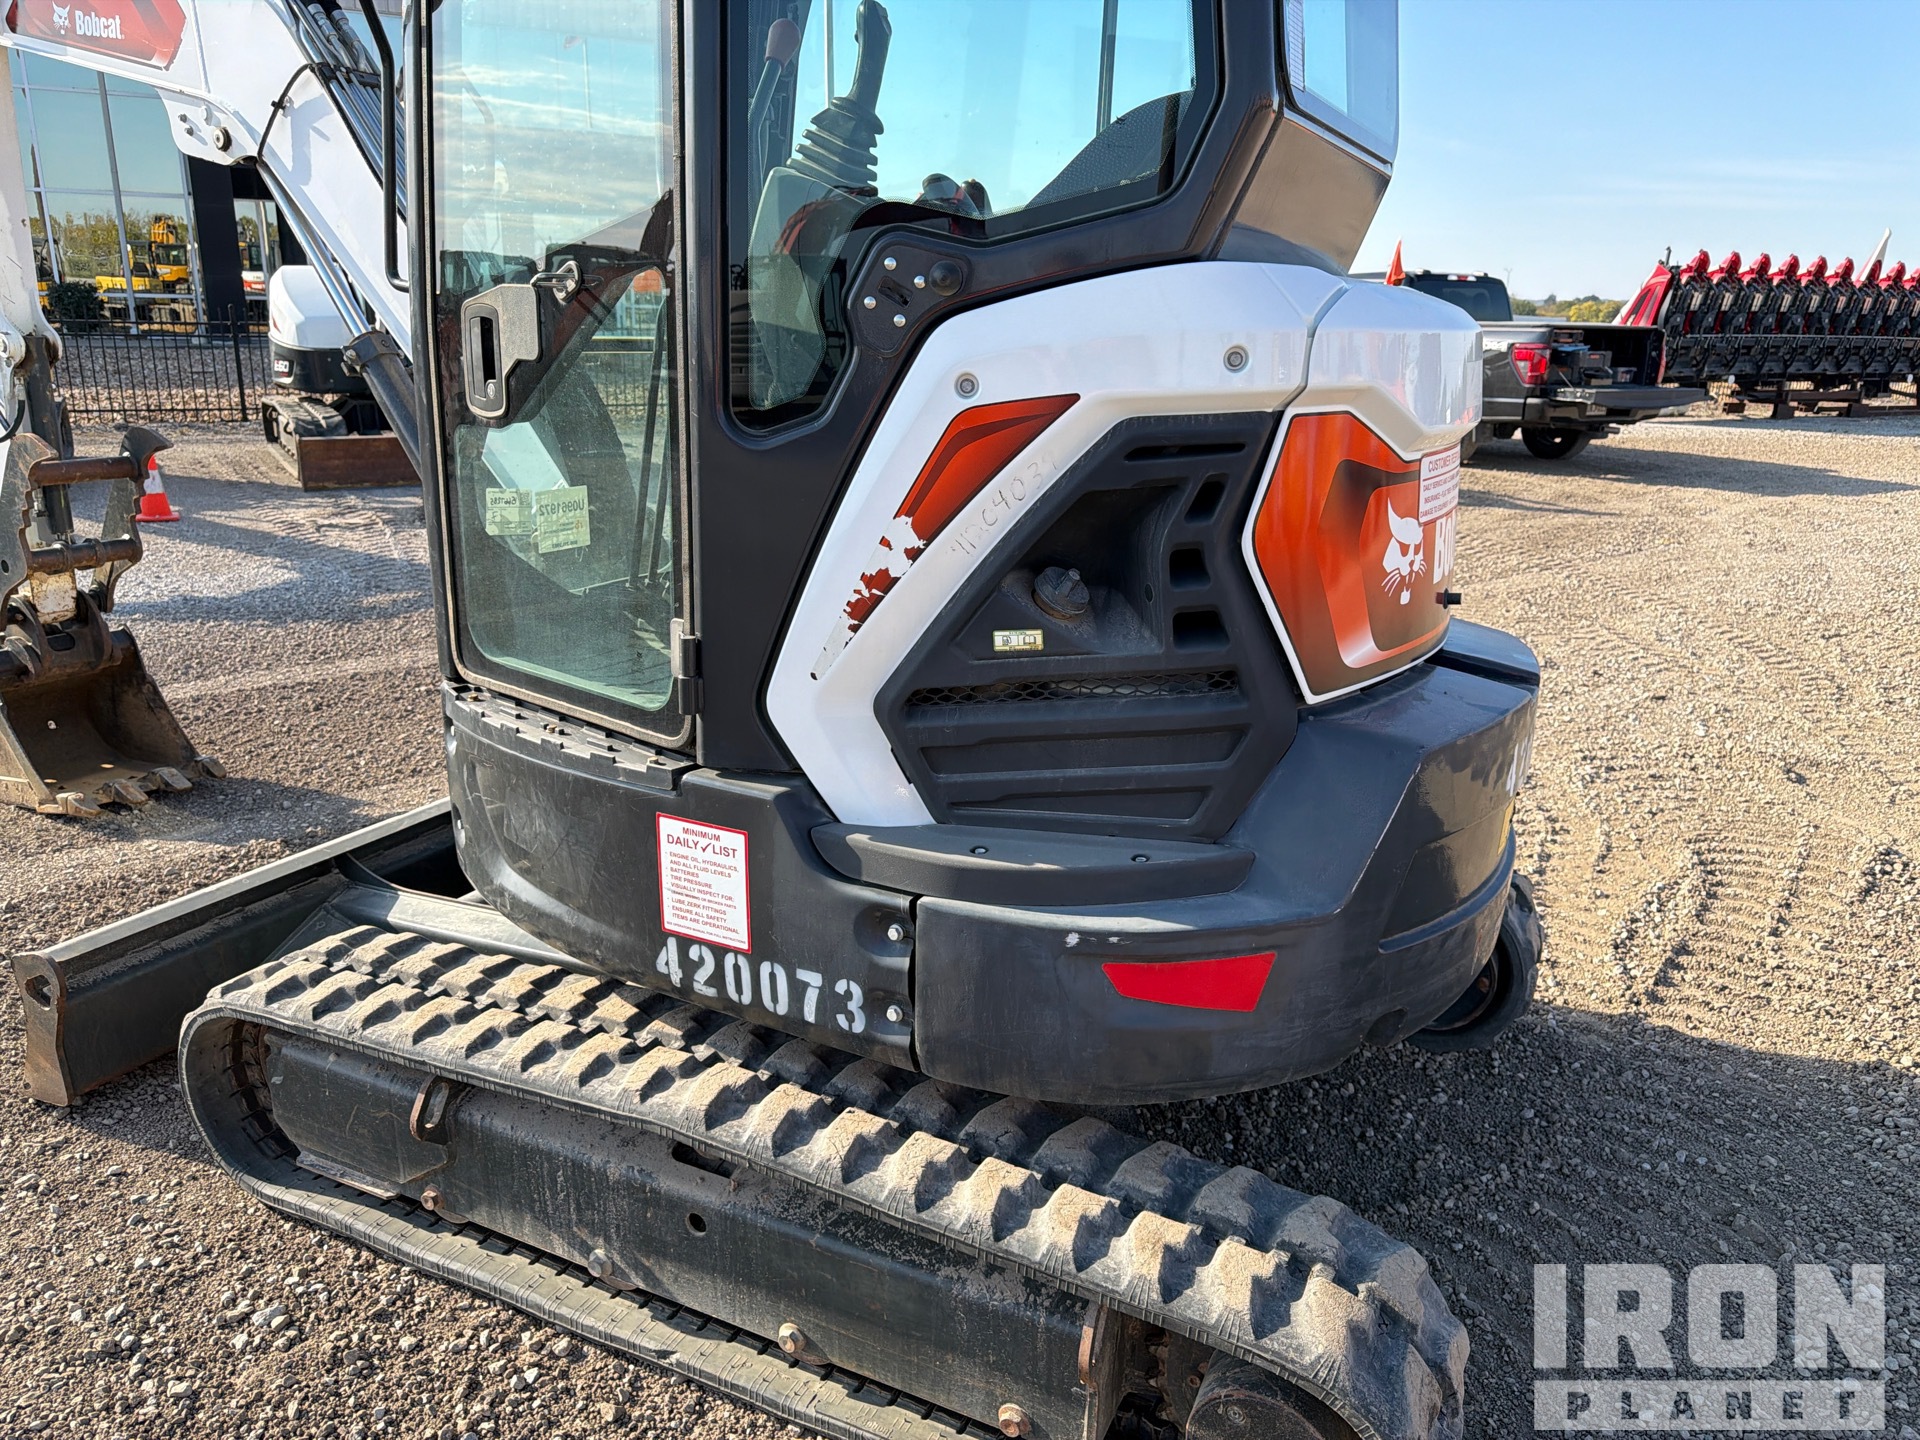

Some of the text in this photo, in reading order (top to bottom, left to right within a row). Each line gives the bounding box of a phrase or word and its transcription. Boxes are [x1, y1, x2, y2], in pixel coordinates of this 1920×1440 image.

[75, 10, 122, 40] Bobcat
[682, 826, 720, 841] MINIMUM
[666, 833, 737, 858] DAILY LIST
[669, 851, 688, 860] ENGINE
[670, 867, 698, 878] BATTERIES
[710, 868, 731, 877] LEVELS
[670, 882, 695, 892] VISUALLY
[697, 888, 719, 898] INSPECT
[683, 877, 712, 888] PRESSURE
[672, 905, 693, 914] ENSURE
[706, 913, 726, 923] SAFETY
[702, 905, 726, 915] FITTINGS
[672, 912, 688, 921] ITEMS
[701, 920, 739, 934] OPERATIONAL
[656, 936, 866, 1034] 420073
